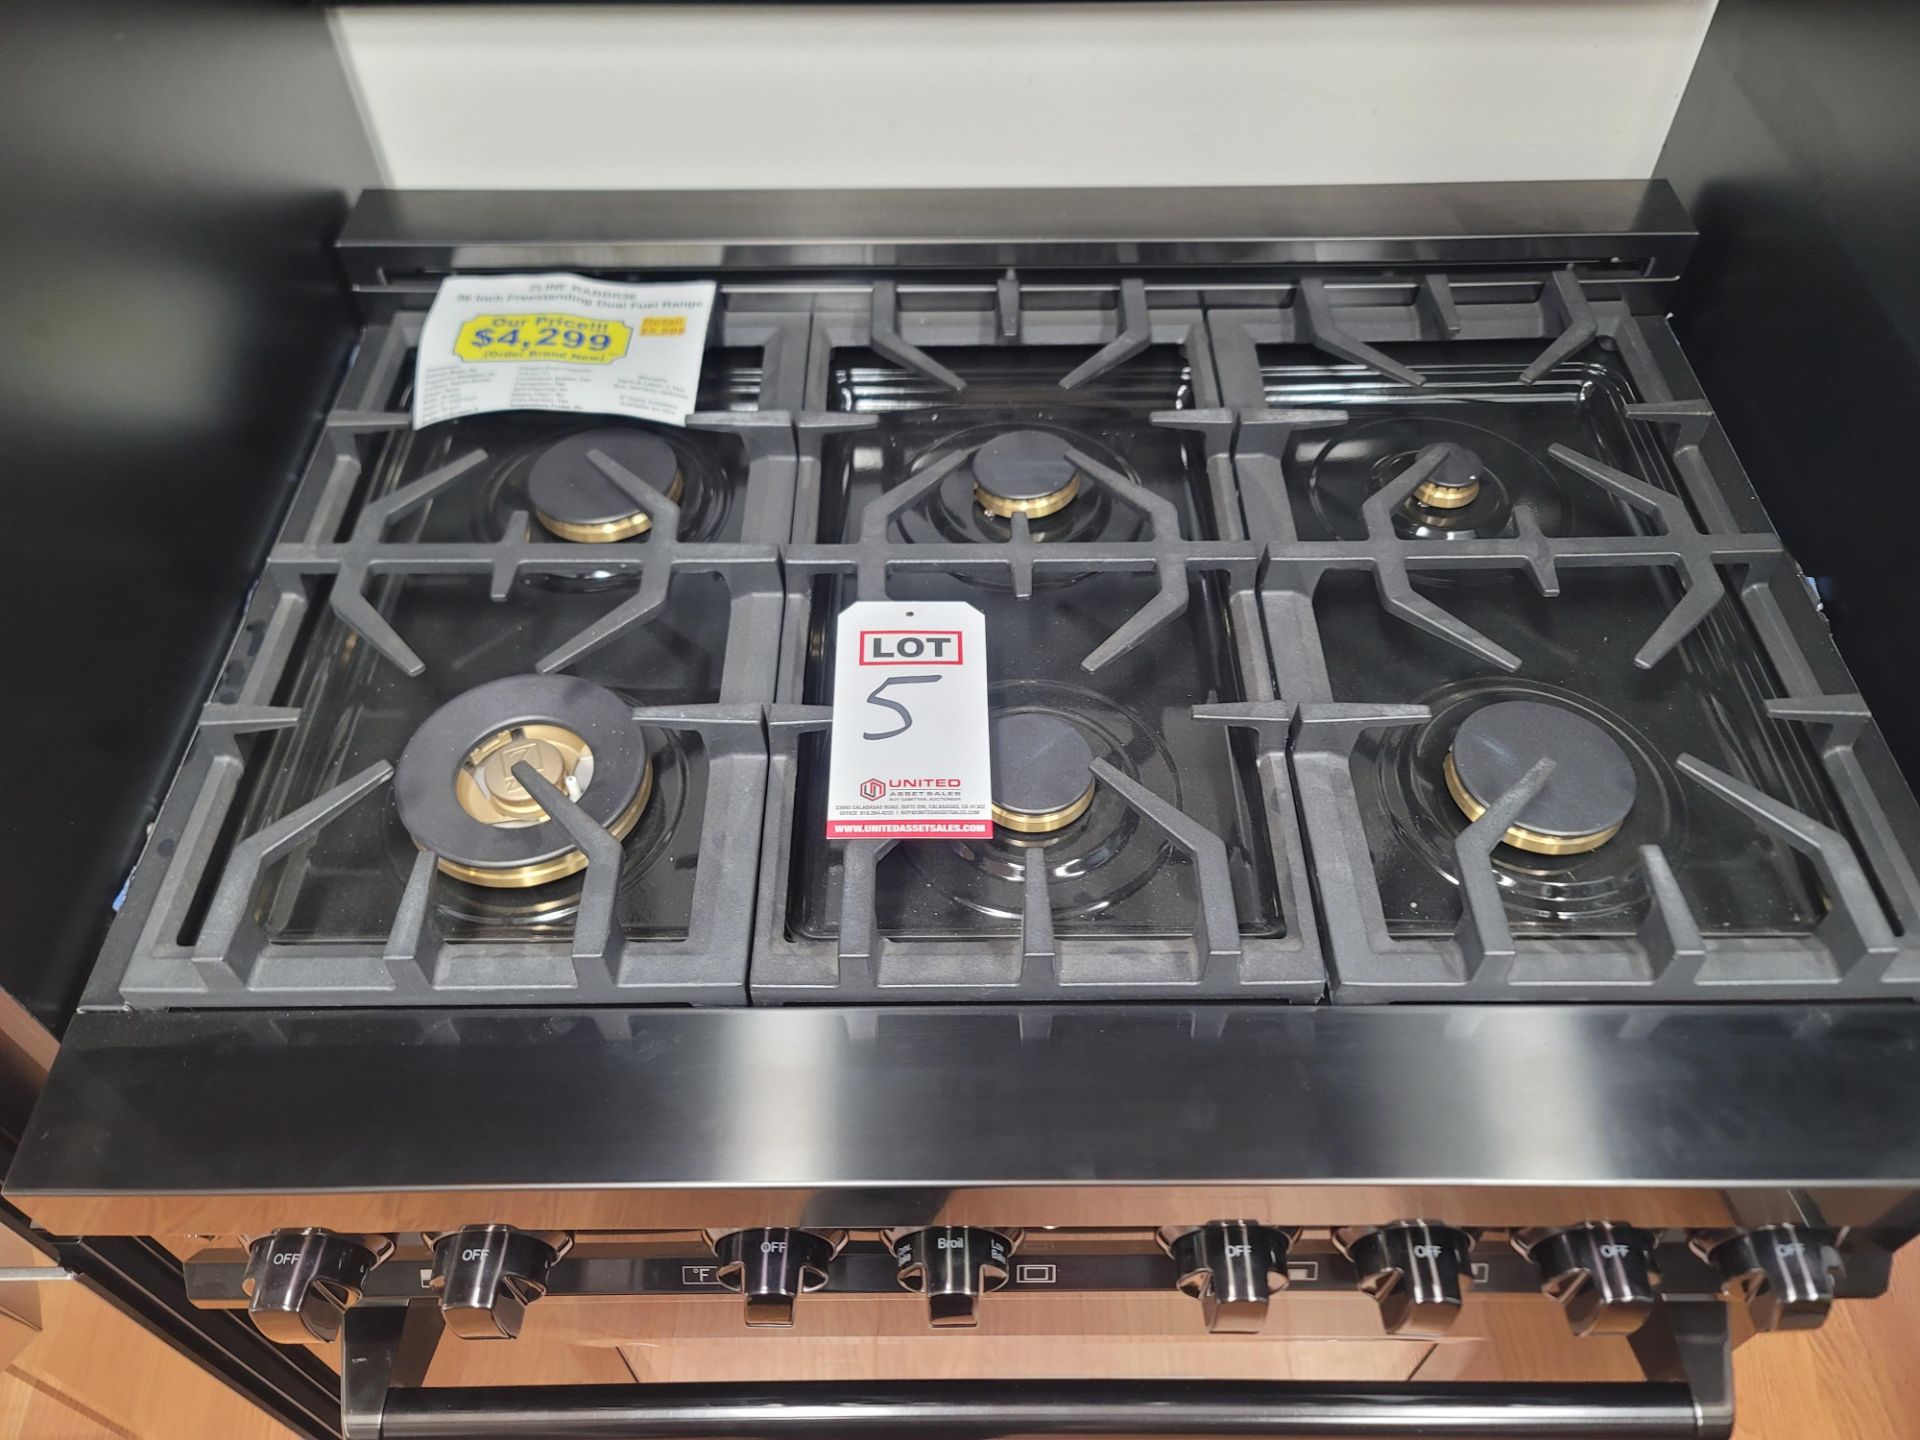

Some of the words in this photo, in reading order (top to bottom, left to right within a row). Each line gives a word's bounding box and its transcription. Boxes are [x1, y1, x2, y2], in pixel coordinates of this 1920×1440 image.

[475, 294, 504, 303] Inch
[507, 292, 593, 307] Freestanding
[597, 300, 627, 310] Dual
[631, 301, 658, 310] Fuel
[661, 301, 703, 310] Range
[492, 318, 528, 328] Our
[536, 316, 609, 334] Price!!!
[471, 327, 612, 352] $4,299
[529, 351, 568, 360] Brand
[873, 637, 952, 658] LOT
[863, 674, 943, 740] 5
[889, 779, 961, 788] UNITED
[834, 824, 986, 833] WWW.UNITEDASSETSALES.COM
[760, 1242, 787, 1253] OFF
[937, 1237, 964, 1249] Broil
[462, 1248, 489, 1261] OFF
[1225, 1246, 1253, 1257] OFF
[1414, 1245, 1442, 1258] OFF
[1600, 1244, 1630, 1258] OFF
[1777, 1243, 1805, 1257] OFF
[273, 1252, 300, 1265] OFF
